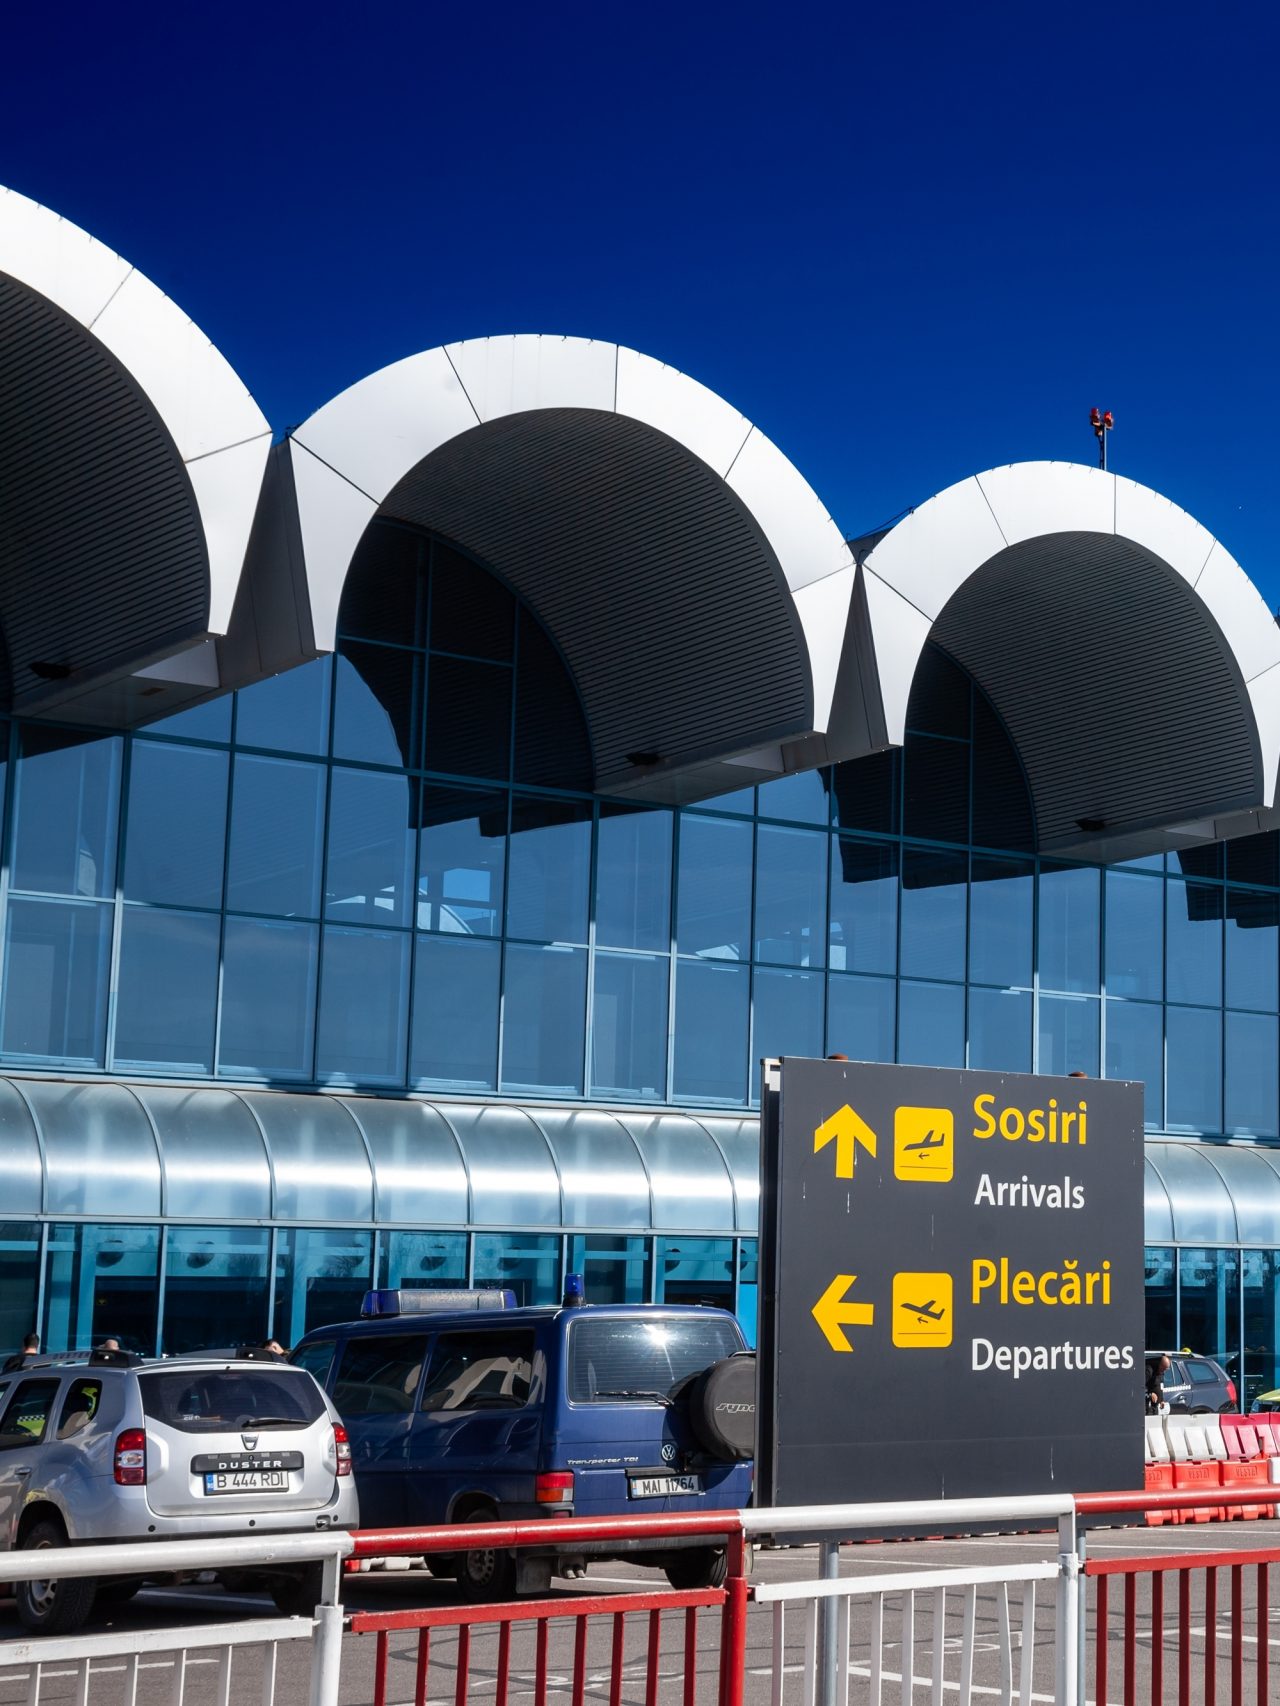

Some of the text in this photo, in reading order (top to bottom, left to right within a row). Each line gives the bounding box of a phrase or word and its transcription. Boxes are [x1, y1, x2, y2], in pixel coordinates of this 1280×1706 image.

[973, 1094, 1087, 1144] Sosiri
[974, 1174, 1085, 1208] Arrivals
[972, 1257, 1111, 1304] Plecări
[972, 1338, 1134, 1379] Departures
[217, 1472, 284, 1488] B 444 RDI
[218, 1460, 282, 1470] DUSTER
[642, 1480, 661, 1494] MAI
